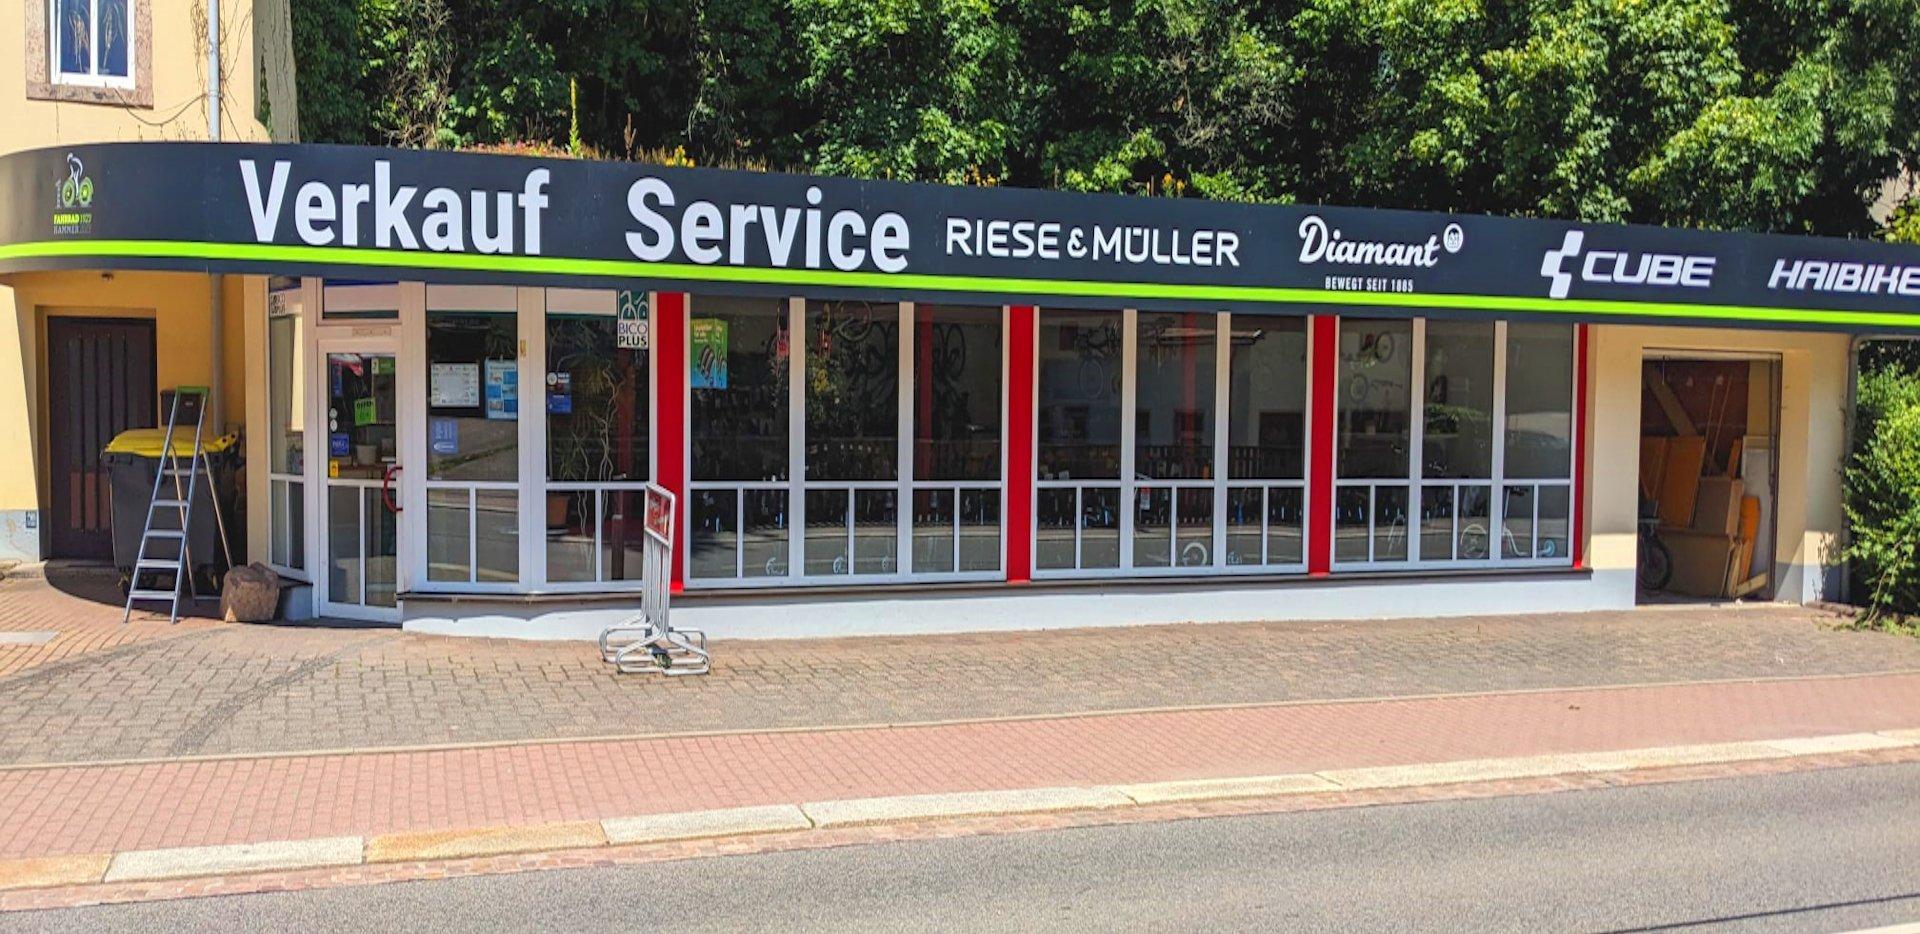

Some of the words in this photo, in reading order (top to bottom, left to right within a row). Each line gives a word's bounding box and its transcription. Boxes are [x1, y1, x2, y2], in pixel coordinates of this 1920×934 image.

[239, 159, 550, 255] Verkauf
[625, 177, 910, 273] Service
[946, 218, 1061, 259] RIESE
[1067, 227, 1088, 258] &
[1092, 225, 1240, 267] MÜLLER
[1298, 215, 1441, 267] Diamant
[1325, 276, 1363, 291] BEWEGT
[1366, 277, 1388, 292] SEIT
[1581, 251, 1716, 287] CUBE
[1767, 258, 1920, 295] HAIBIKE
[619, 322, 648, 334] BICO
[619, 335, 647, 345] PLUS
